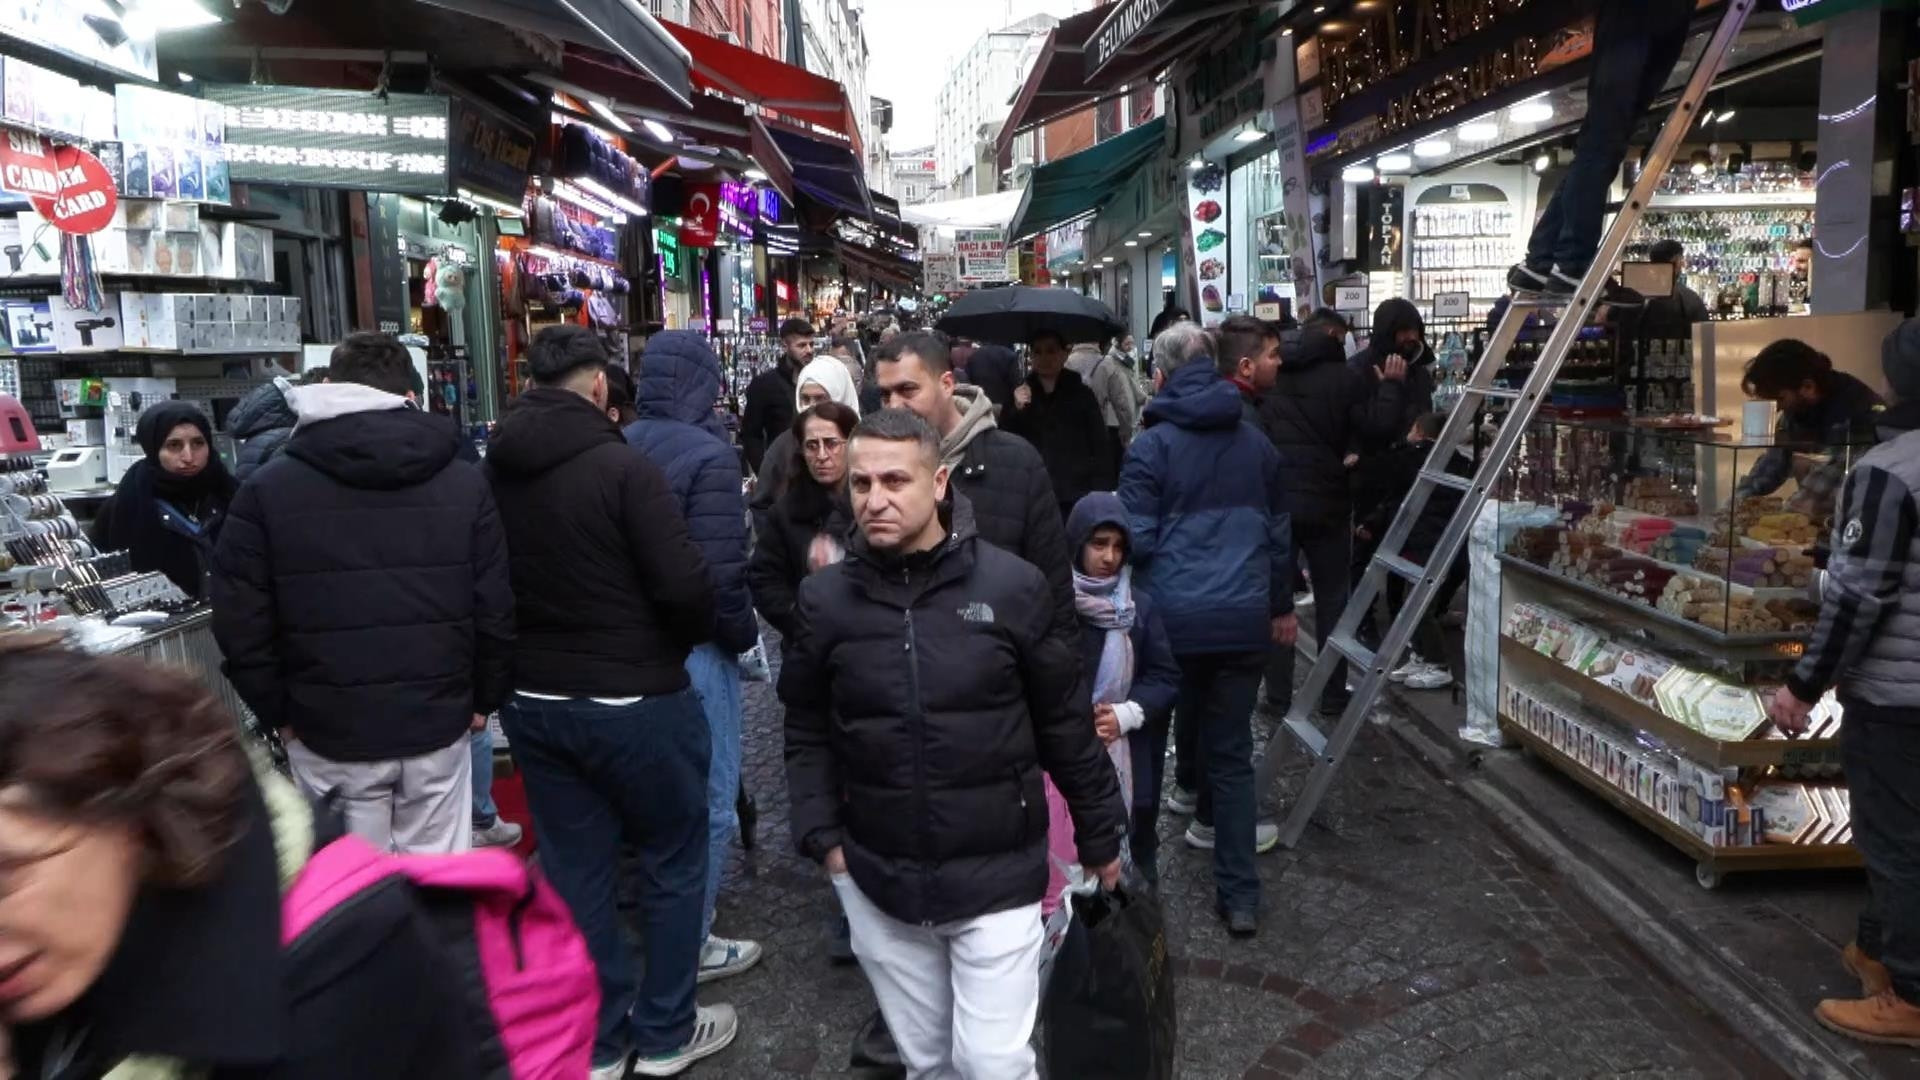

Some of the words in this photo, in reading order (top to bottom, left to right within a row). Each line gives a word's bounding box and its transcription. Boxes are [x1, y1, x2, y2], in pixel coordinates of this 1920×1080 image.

[6, 164, 58, 193] CARD
[53, 190, 107, 219] CARD
[1380, 203, 1393, 266] TOPTAN
[1344, 291, 1360, 300] 200
[1443, 298, 1459, 306] 200
